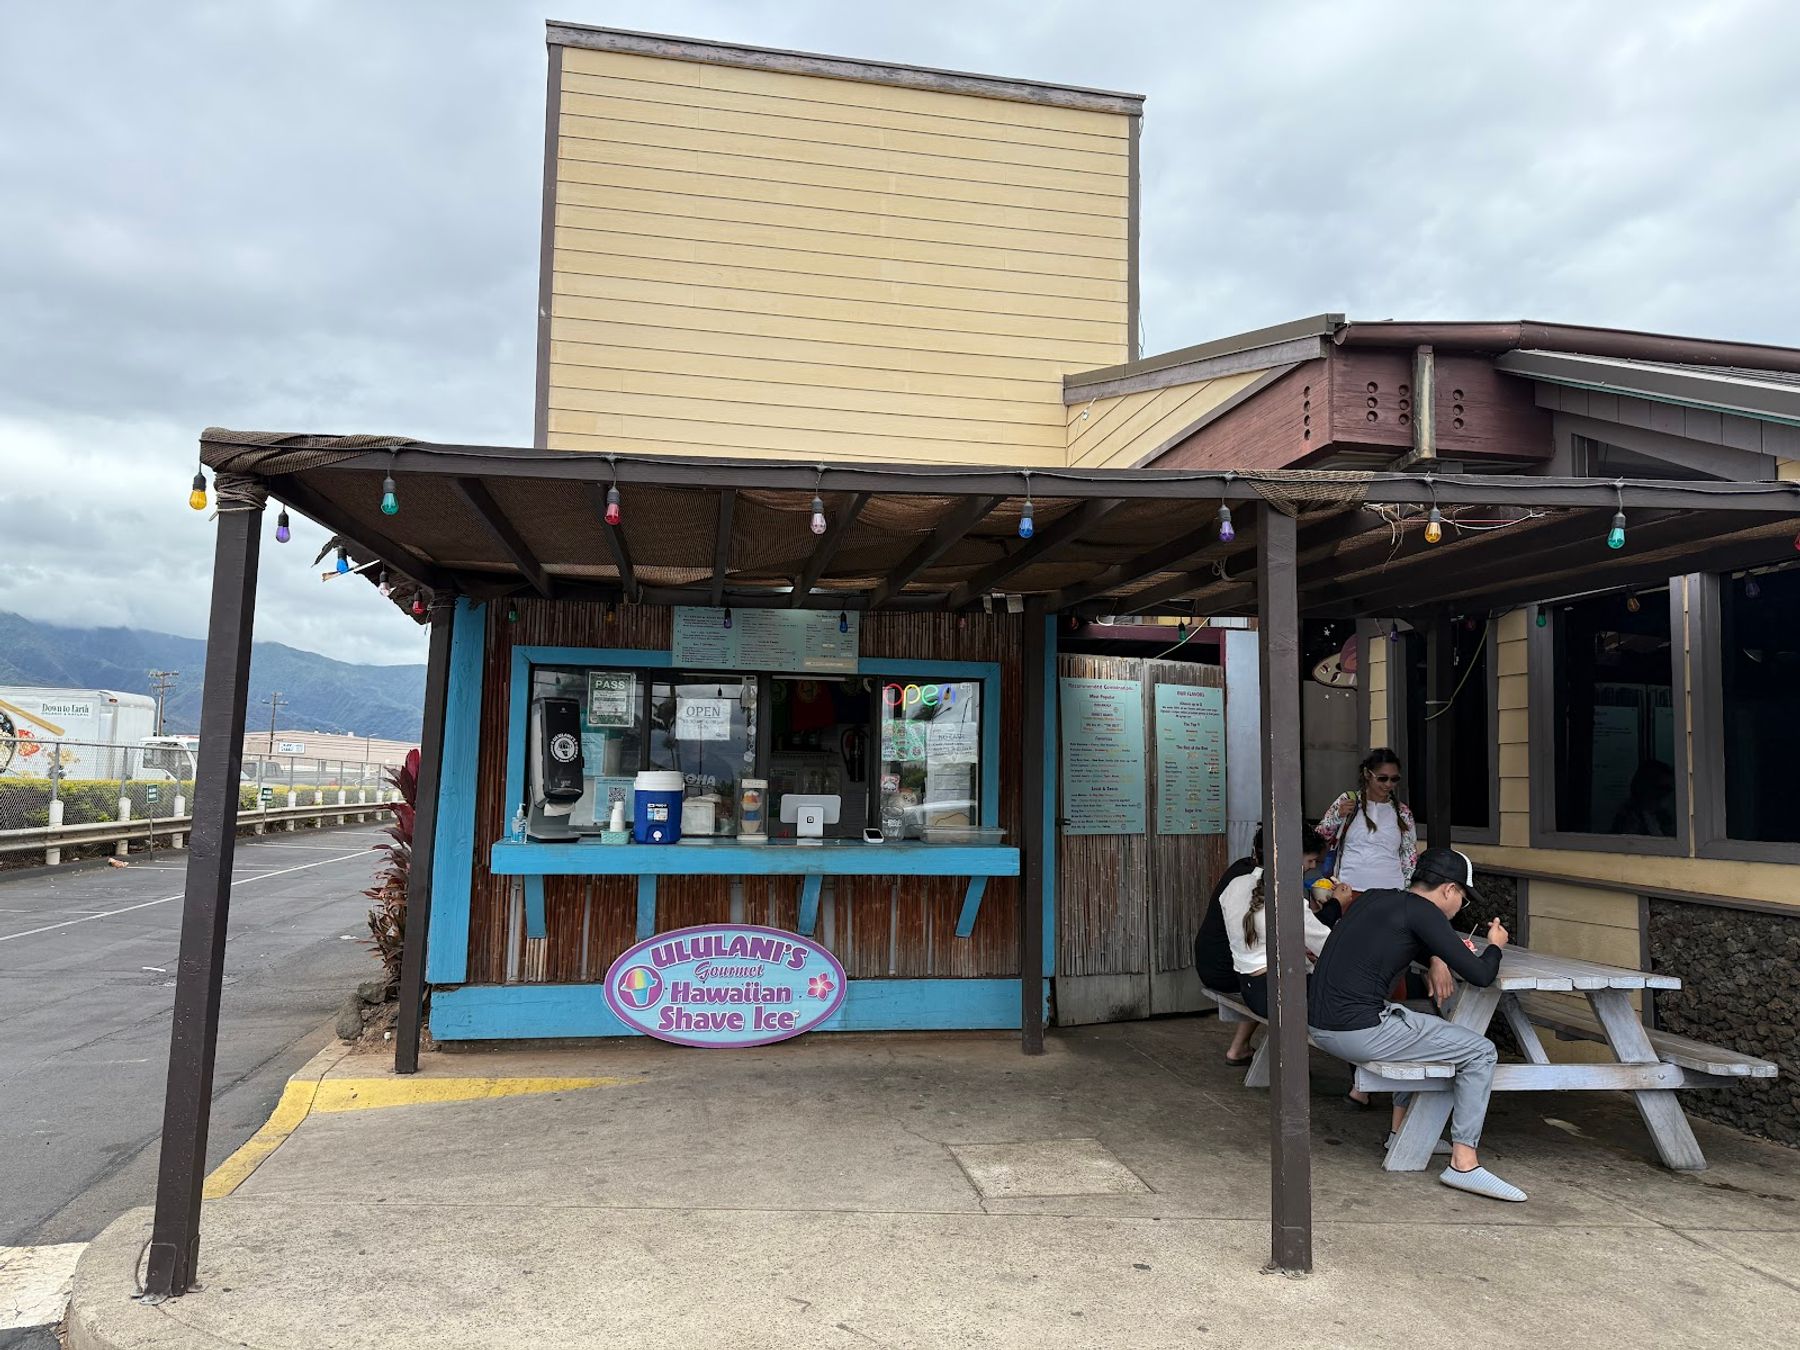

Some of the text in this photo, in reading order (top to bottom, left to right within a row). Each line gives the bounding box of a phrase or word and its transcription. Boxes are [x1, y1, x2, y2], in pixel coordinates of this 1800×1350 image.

[595, 680, 626, 690] PASS
[883, 683, 956, 711] open
[42, 703, 89, 713] Down to Earth
[686, 706, 721, 717] OPEN
[651, 935, 808, 970] ULULANI'S
[694, 961, 764, 980] Gourmet
[670, 981, 792, 1004] Hawaiian
[659, 1005, 796, 1031] Shave Ice
